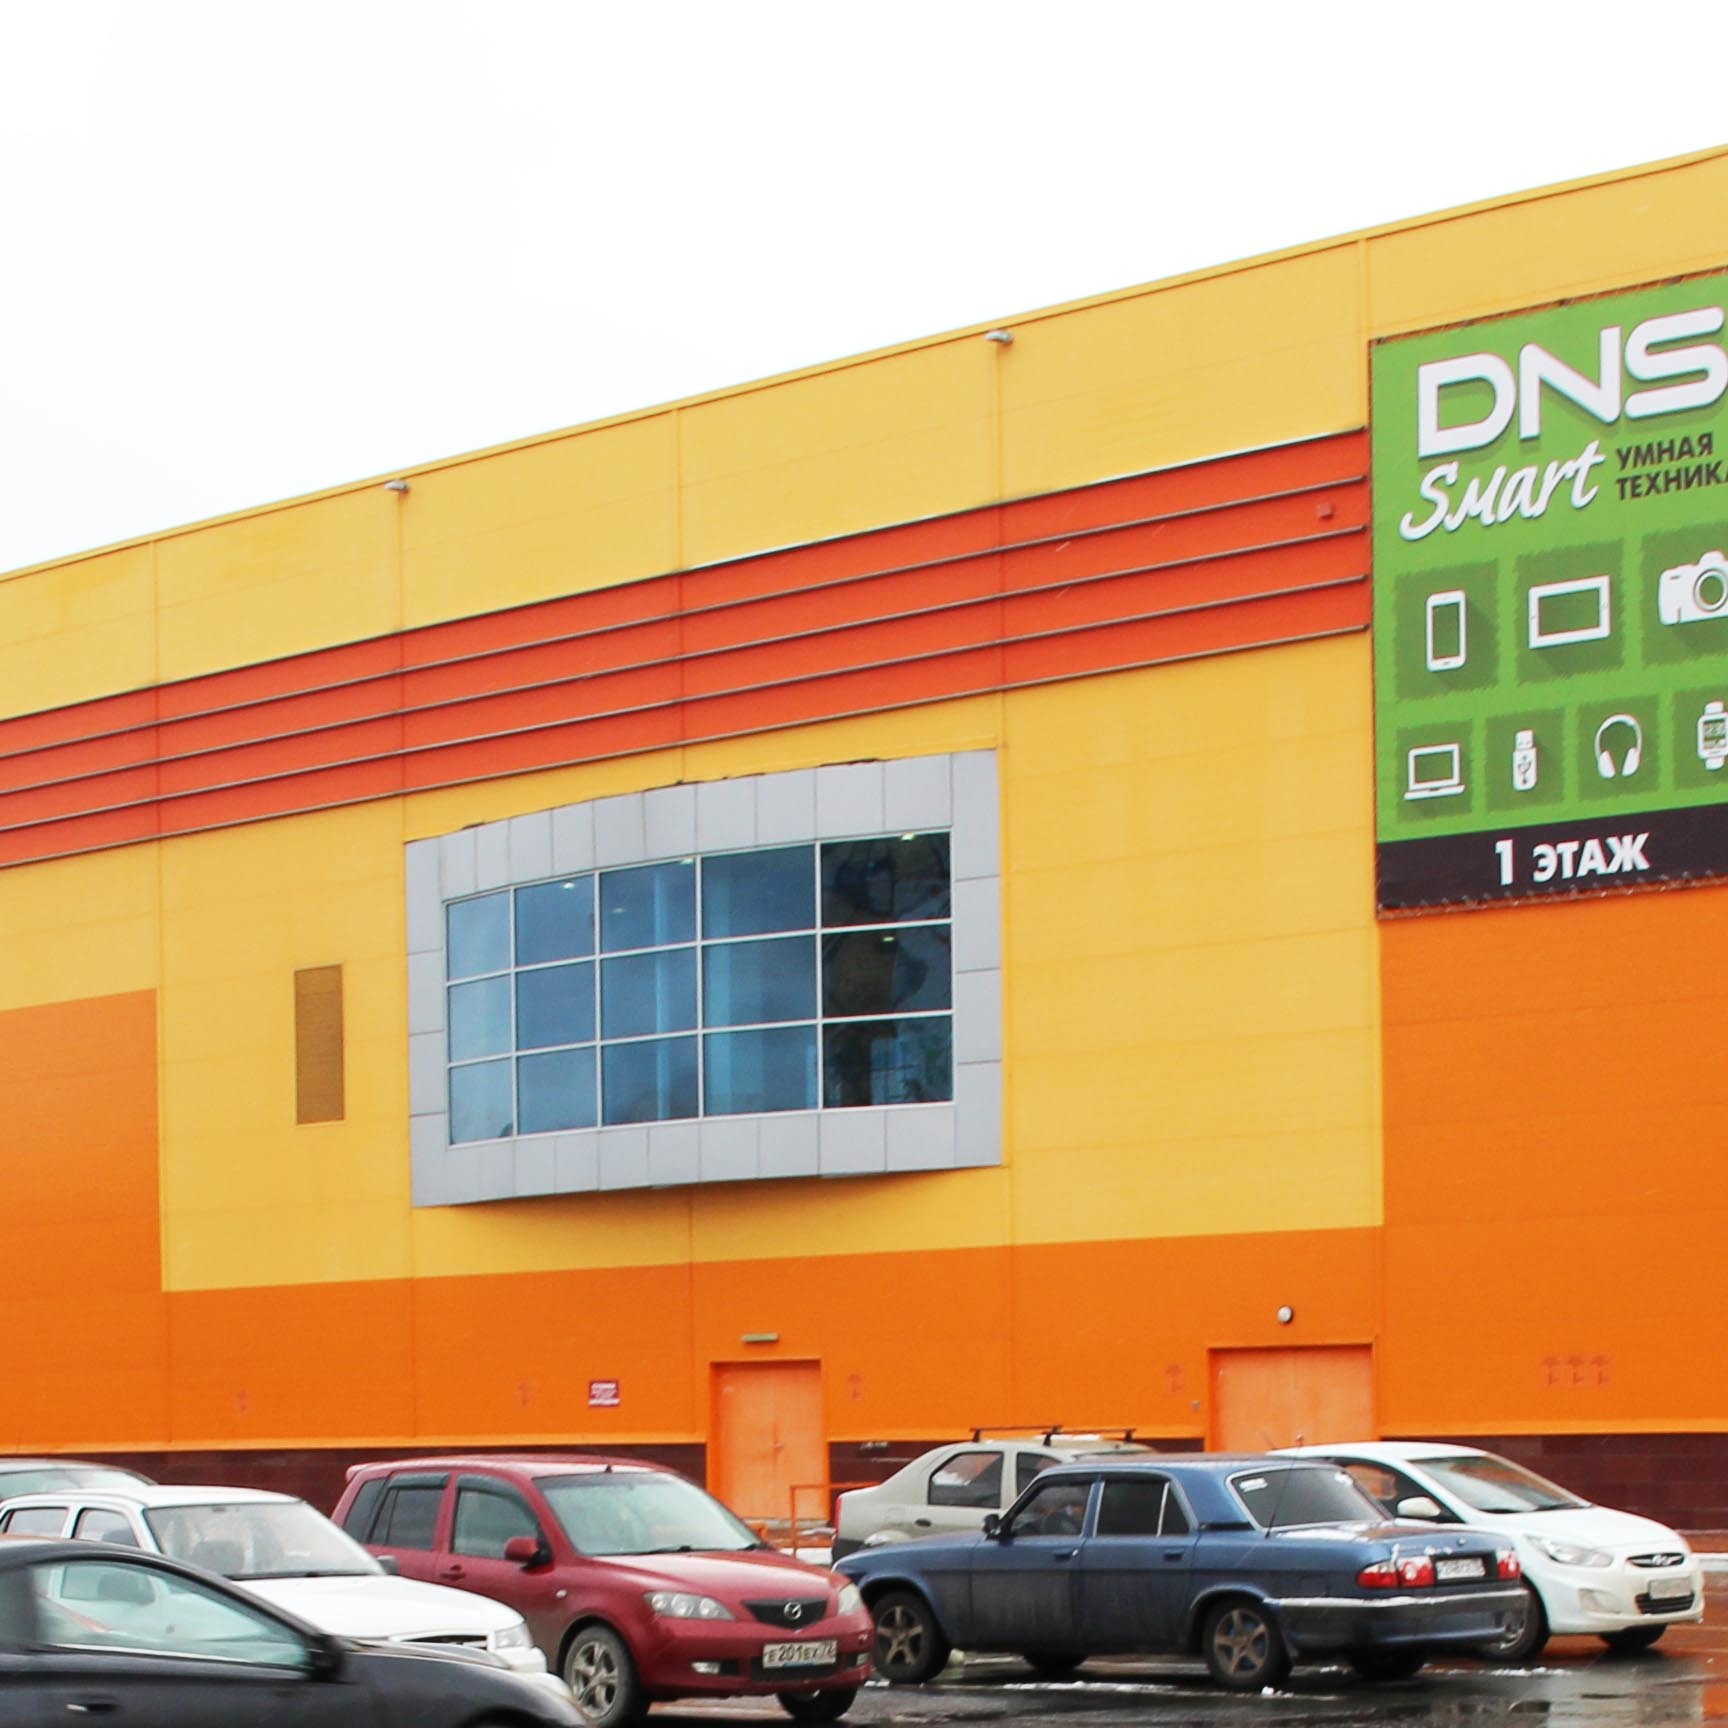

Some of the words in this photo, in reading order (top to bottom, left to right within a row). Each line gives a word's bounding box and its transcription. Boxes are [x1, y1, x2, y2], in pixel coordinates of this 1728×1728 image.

[1615, 431, 1714, 471] УМНАЯ
[1400, 439, 1606, 541] Smart
[1495, 840, 1515, 887] 1
[1532, 832, 1652, 882] ЭТАЖ
